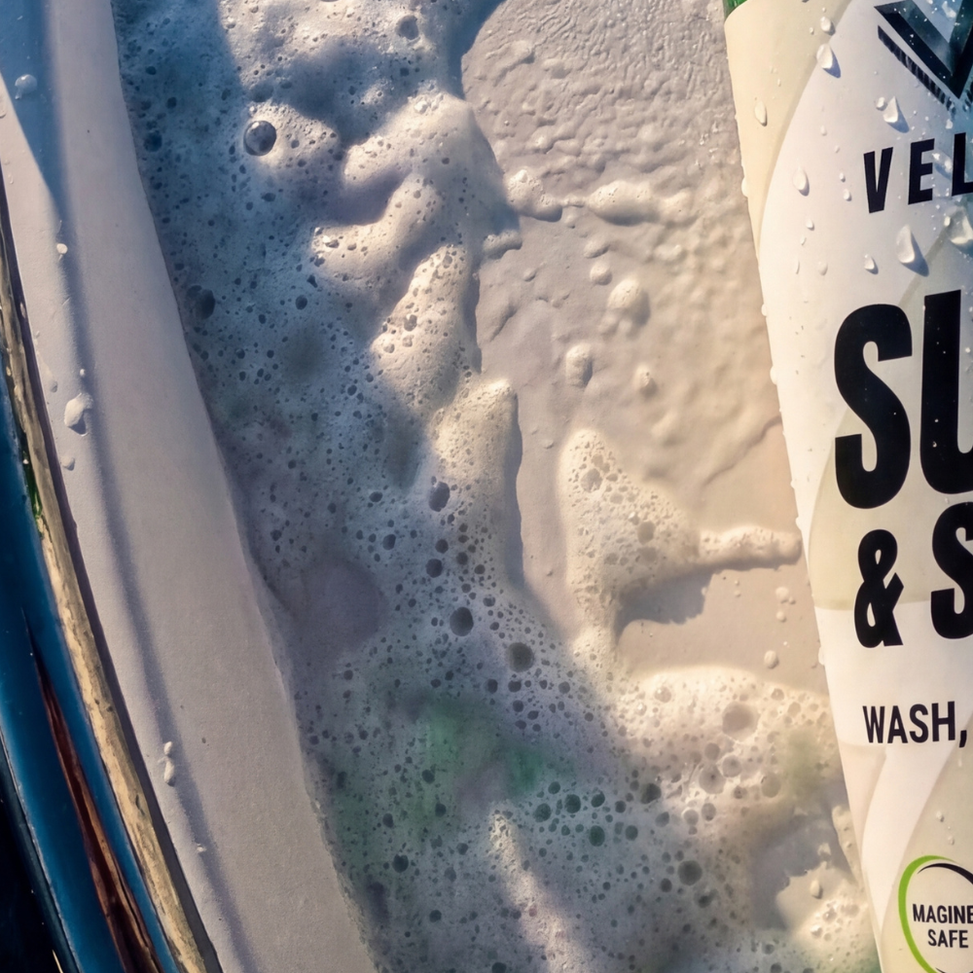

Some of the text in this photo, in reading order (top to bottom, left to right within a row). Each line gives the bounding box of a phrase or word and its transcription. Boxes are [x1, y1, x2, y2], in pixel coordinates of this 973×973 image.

[854, 529, 904, 648] &
[862, 701, 968, 748] WASH,
[927, 928, 969, 948] SAFE
